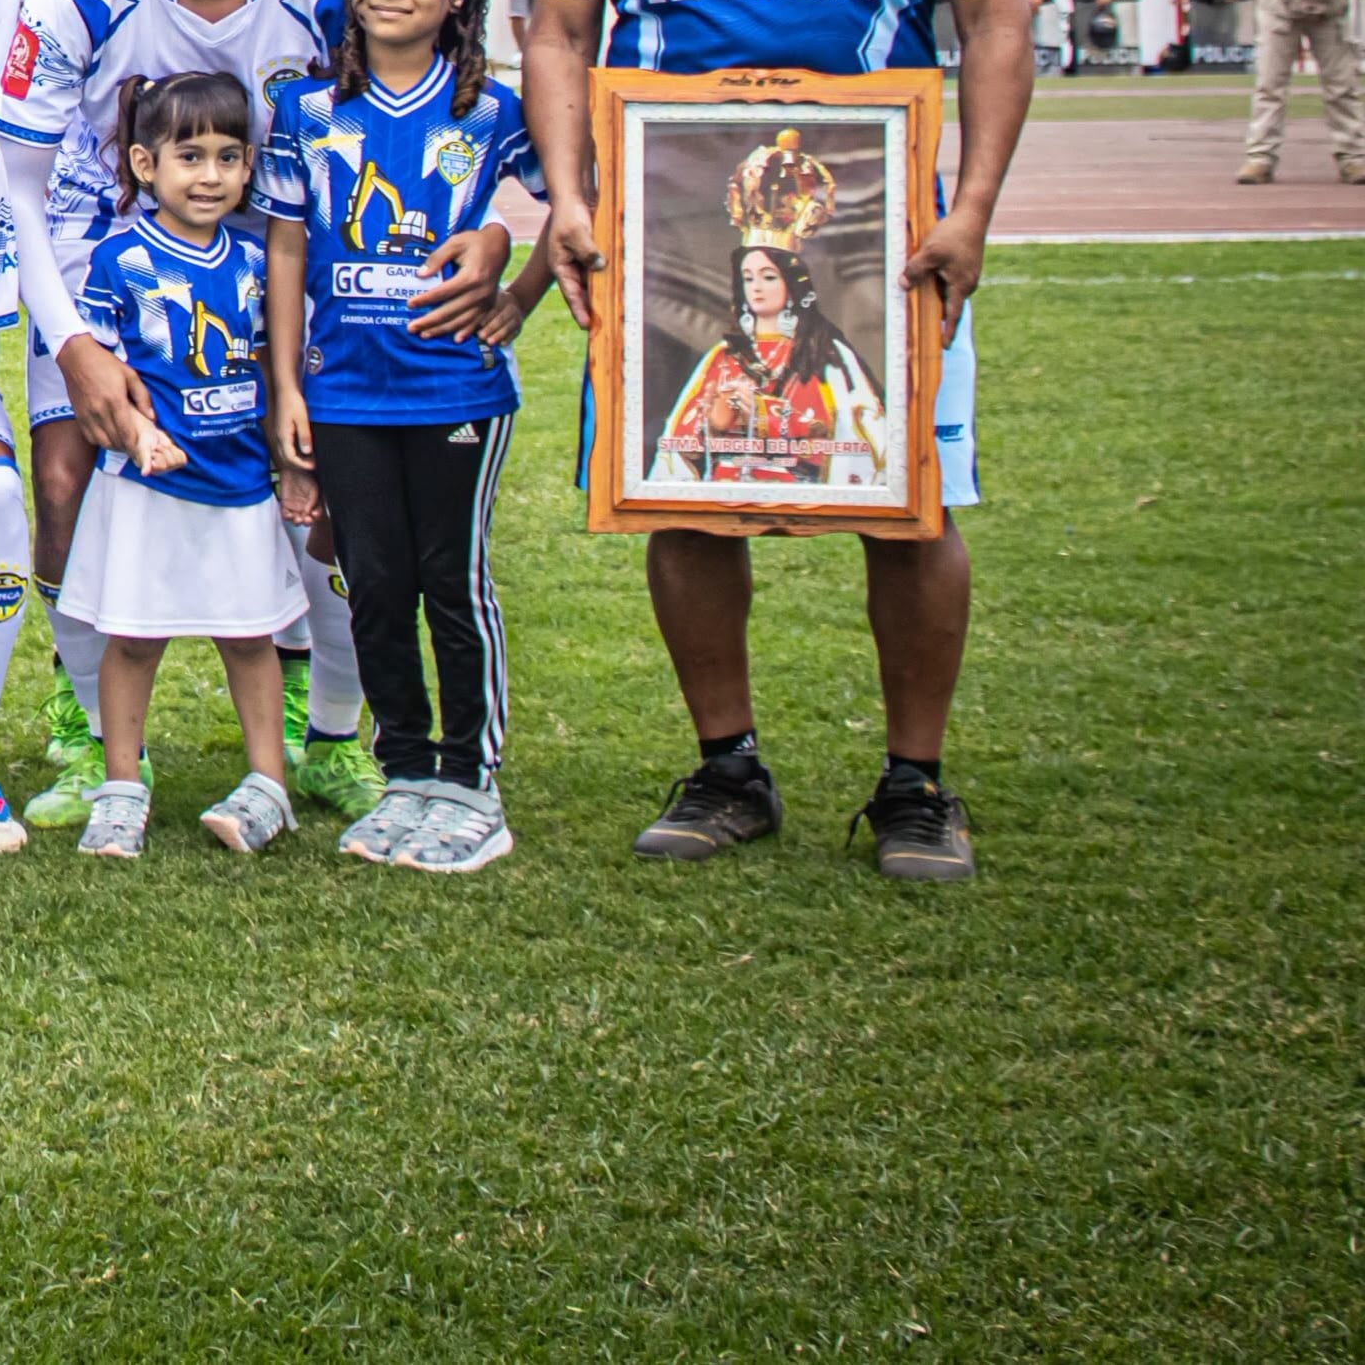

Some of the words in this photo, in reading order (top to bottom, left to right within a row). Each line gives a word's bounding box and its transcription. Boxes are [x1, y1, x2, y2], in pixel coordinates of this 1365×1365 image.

[335, 266, 374, 294] GC
[386, 266, 421, 281] GAM
[386, 287, 429, 299] CARRE
[375, 316, 409, 326] CARRE
[185, 389, 221, 413] GC
[708, 438, 765, 453] VIRGEN
[768, 439, 789, 453] DE
[790, 439, 814, 453] LA
[814, 440, 871, 454] PUERTA
